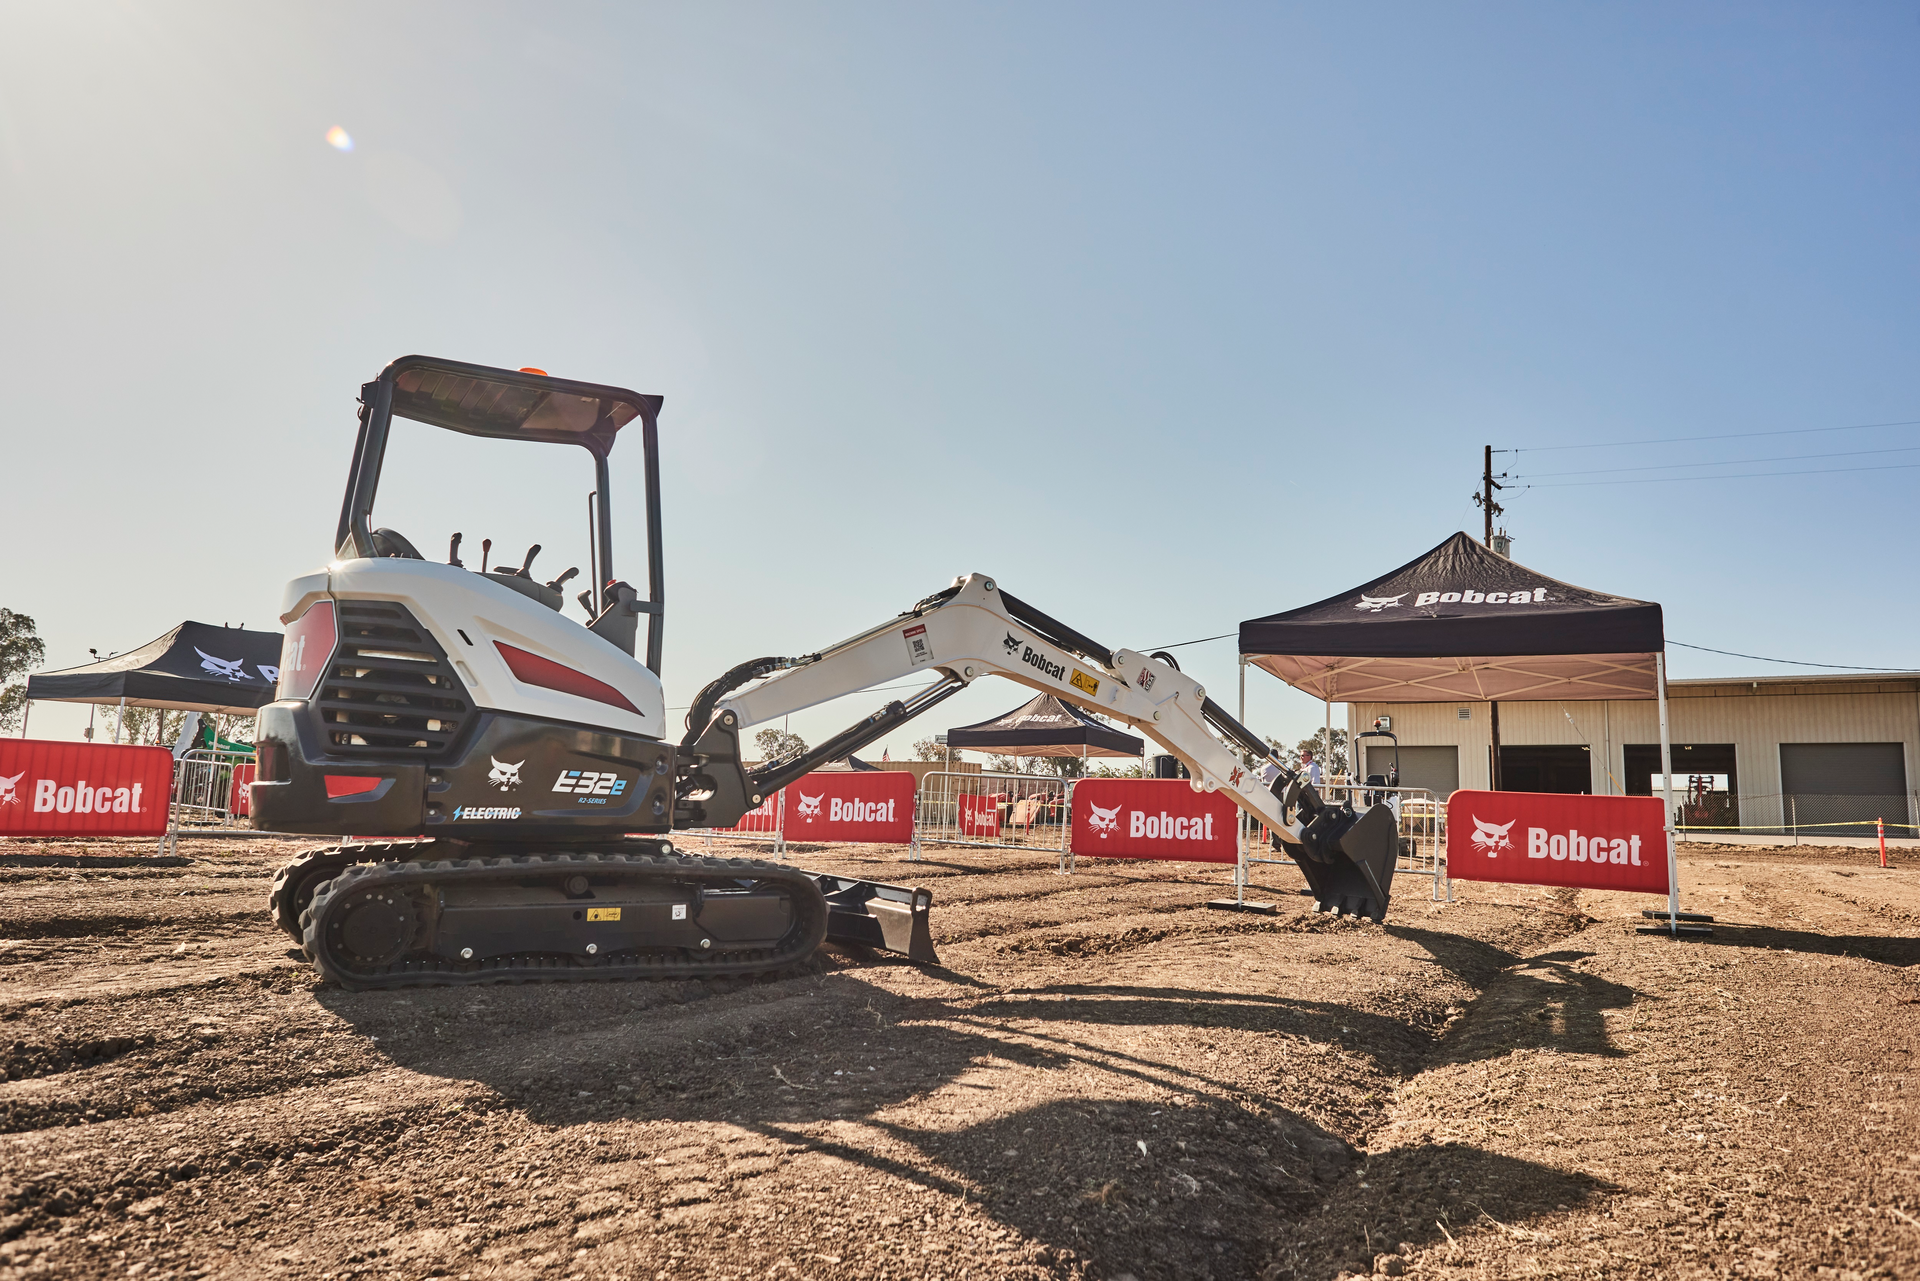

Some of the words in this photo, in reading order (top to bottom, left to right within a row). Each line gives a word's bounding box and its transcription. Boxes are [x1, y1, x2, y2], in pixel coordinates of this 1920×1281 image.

[1414, 587, 1549, 607] Bobcat
[1021, 645, 1066, 681] Bobcat
[33, 779, 143, 813] Bobcat
[577, 797, 607, 805] R2-SERIES
[829, 797, 896, 822] Bobcat
[462, 807, 522, 820] ELECTRIC
[1129, 810, 1214, 841] Bobcat
[1528, 827, 1642, 867] Bobcat
